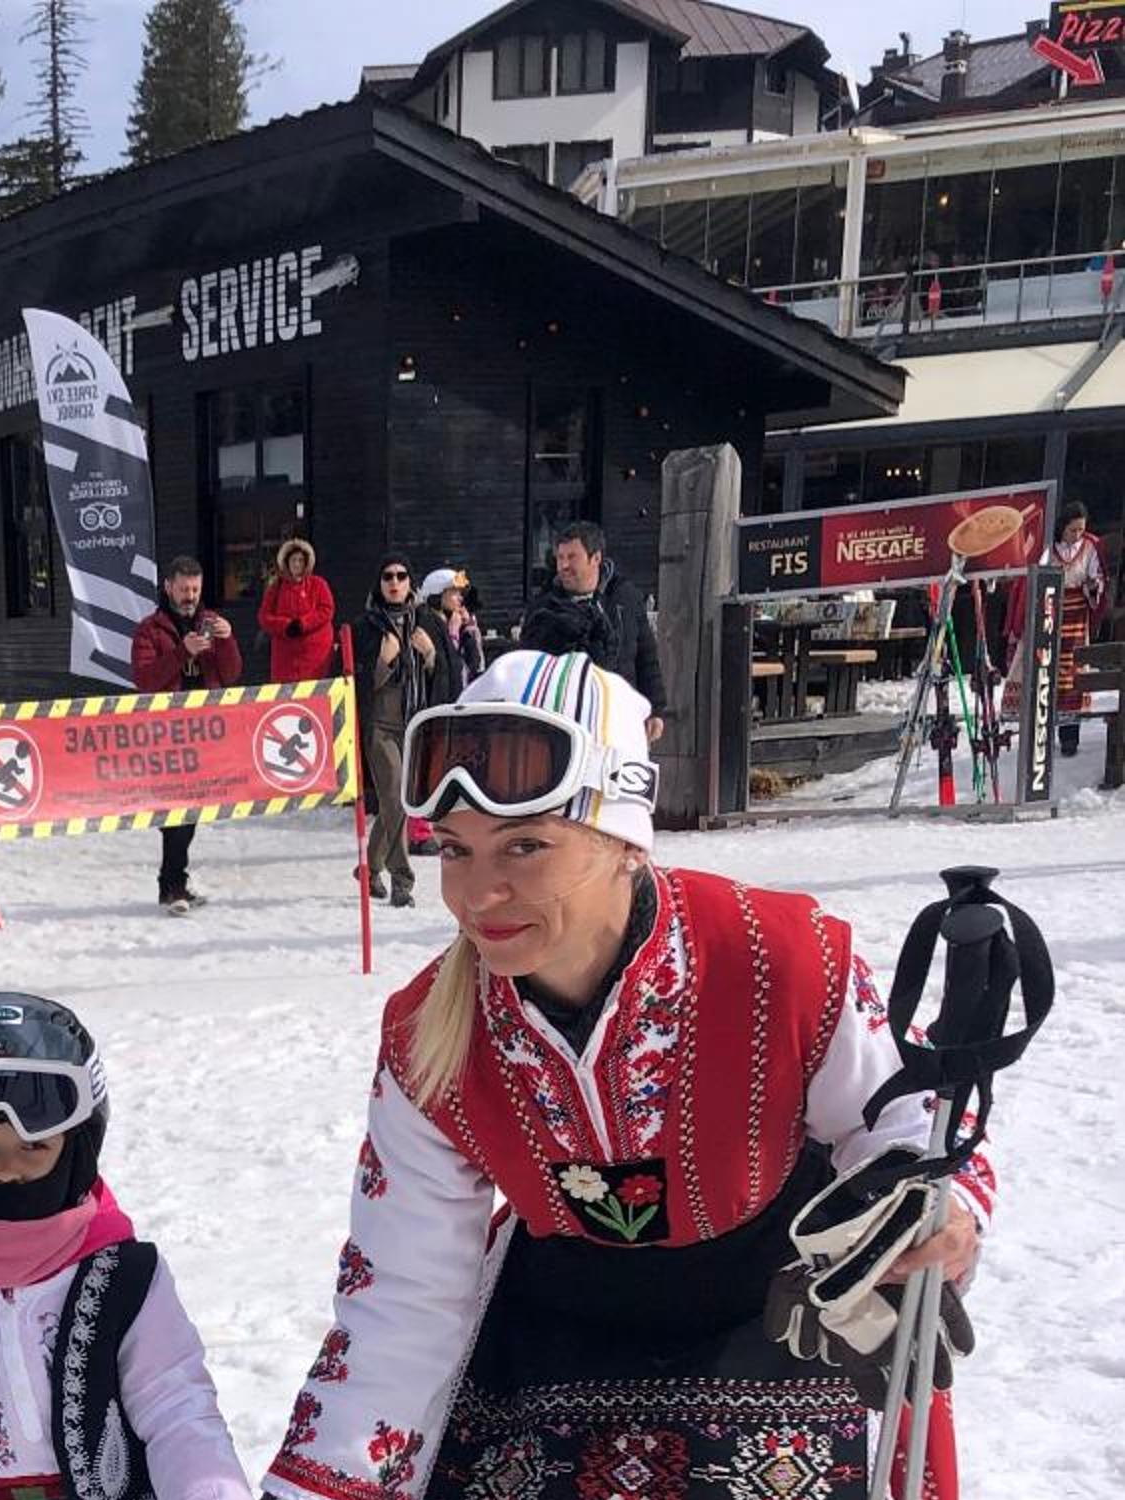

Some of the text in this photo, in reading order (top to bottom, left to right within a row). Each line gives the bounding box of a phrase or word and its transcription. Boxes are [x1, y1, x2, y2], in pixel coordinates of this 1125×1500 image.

[1058, 11, 1125, 47] Pizz
[182, 245, 322, 362] SERVICE
[748, 535, 810, 551] RESTAURANT
[770, 552, 808, 576] FIS
[64, 715, 227, 753] ЗАТВОРЕНО
[95, 749, 201, 781] CLOSED
